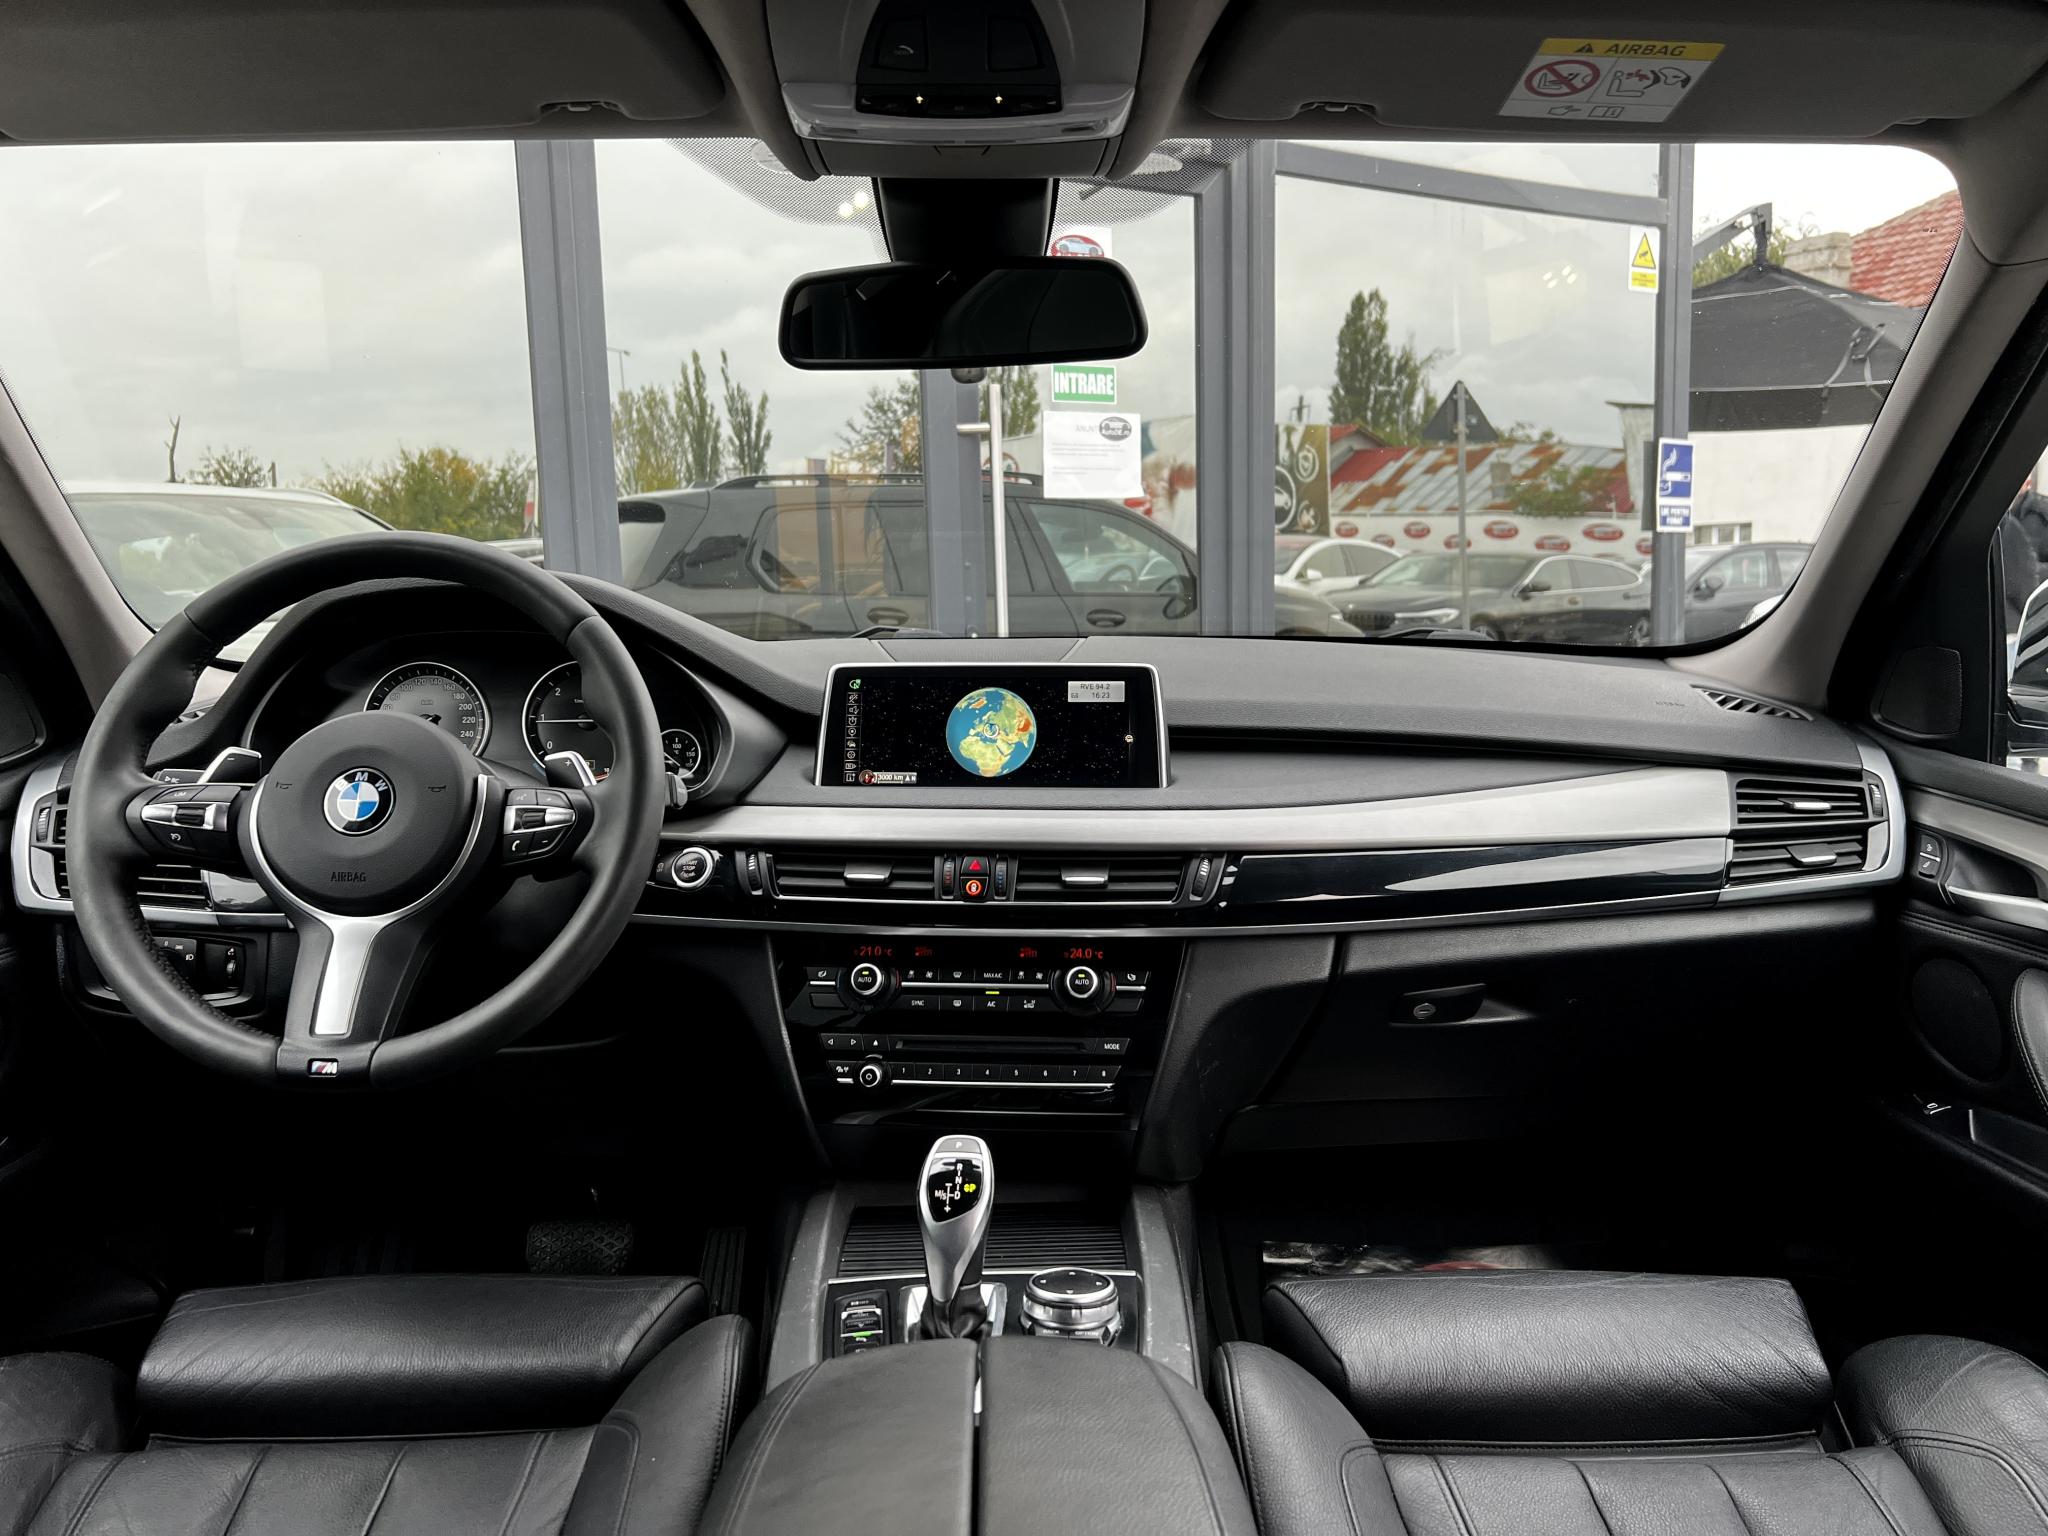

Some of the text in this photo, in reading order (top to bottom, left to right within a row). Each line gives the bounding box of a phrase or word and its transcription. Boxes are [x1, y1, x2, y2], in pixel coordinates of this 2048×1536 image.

[1604, 43, 1686, 57] AIRBAG
[1053, 371, 1115, 396] INTRARE
[554, 688, 561, 696] 2
[540, 713, 545, 721] 1
[546, 741, 553, 749] 0
[334, 771, 388, 792] BMW
[330, 871, 367, 882] AIRBAG
[1070, 949, 1092, 959] 24.0
[955, 1141, 962, 1149] P
[956, 1163, 963, 1171] R
[955, 1176, 963, 1184] N
[934, 1189, 947, 1200] M/S
[954, 1191, 961, 1200] D
